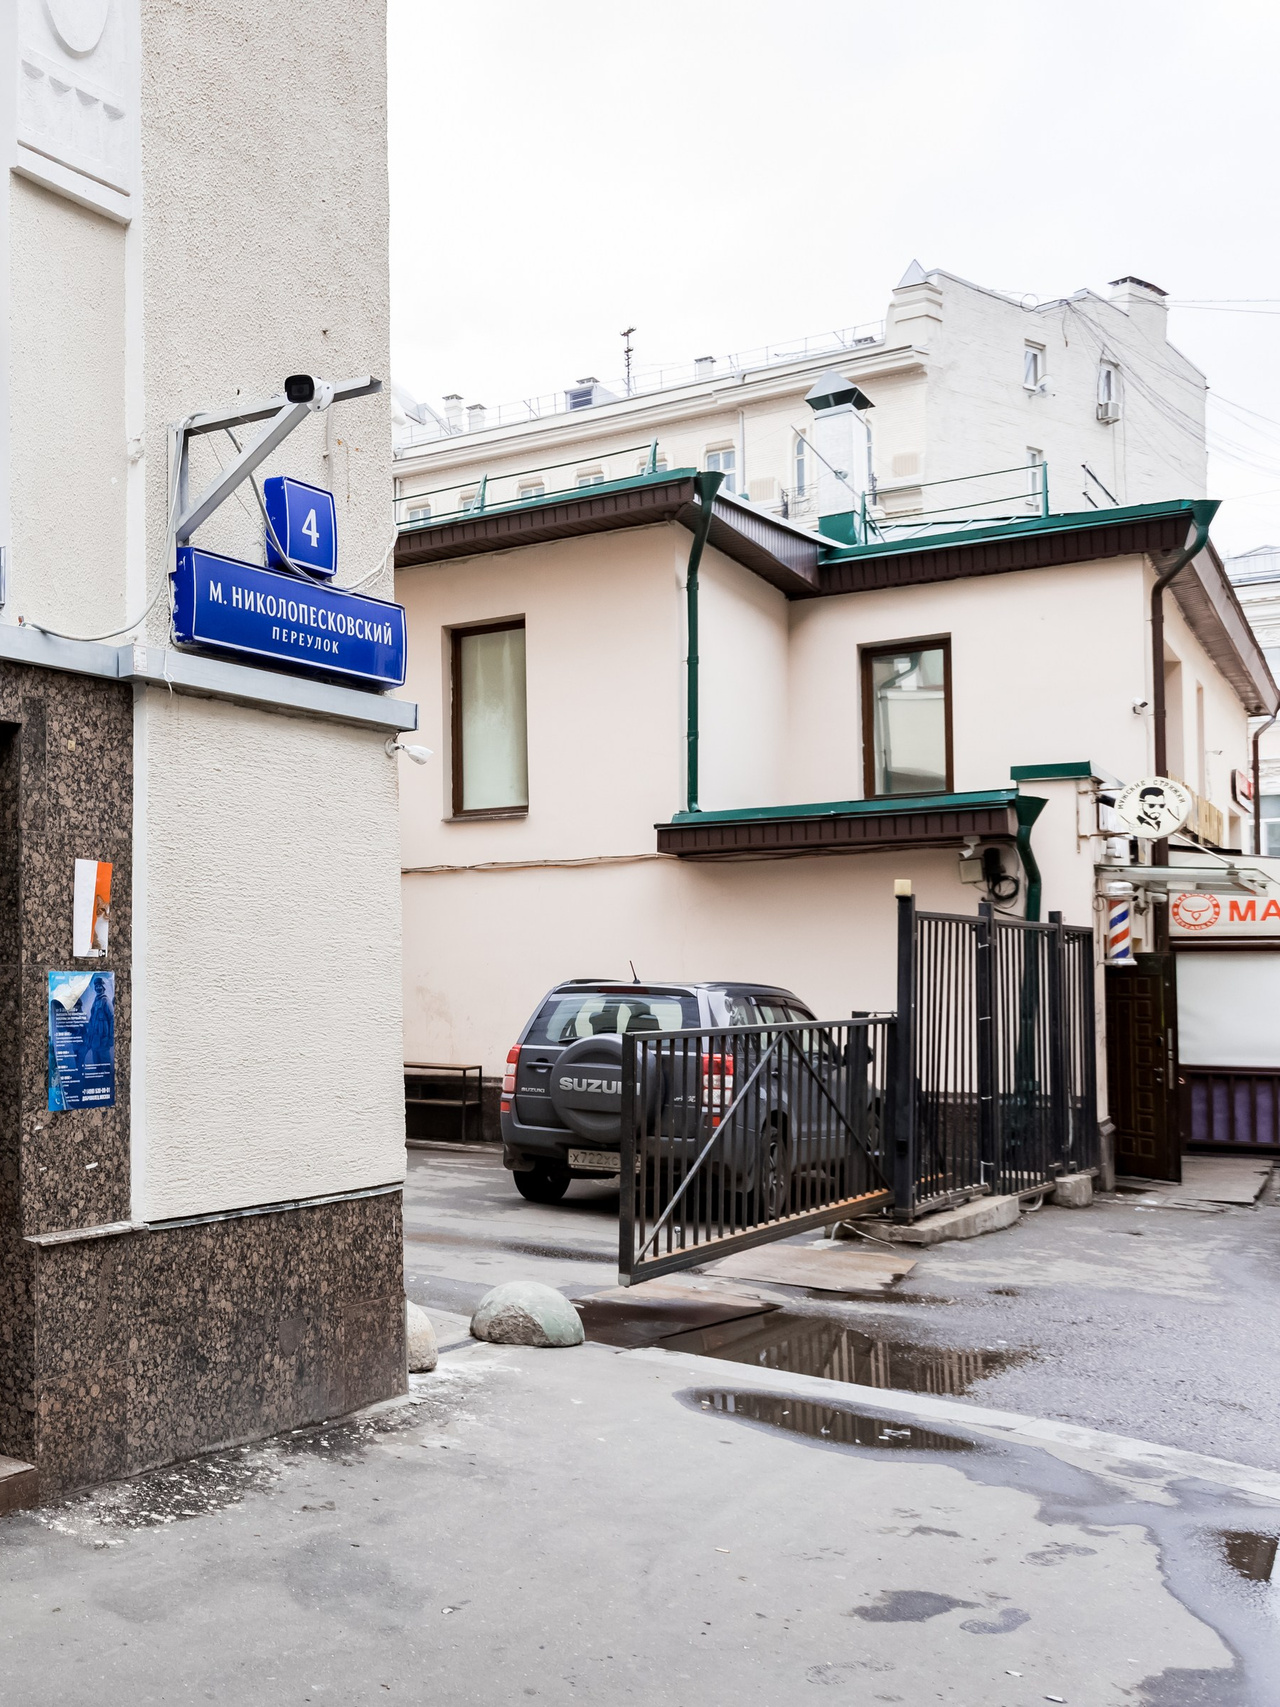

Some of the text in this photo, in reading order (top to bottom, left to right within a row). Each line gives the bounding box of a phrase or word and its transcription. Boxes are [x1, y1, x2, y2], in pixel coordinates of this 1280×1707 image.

[301, 508, 320, 548] 4
[209, 580, 393, 646] М. НИКОЛОПЕСКОВСКИЙ
[272, 626, 339, 654] ПЕРЕУЛОК
[1118, 780, 1186, 809] МУЖСКИЕ СТРИЖКИ
[559, 1077, 641, 1095] SUZUI
